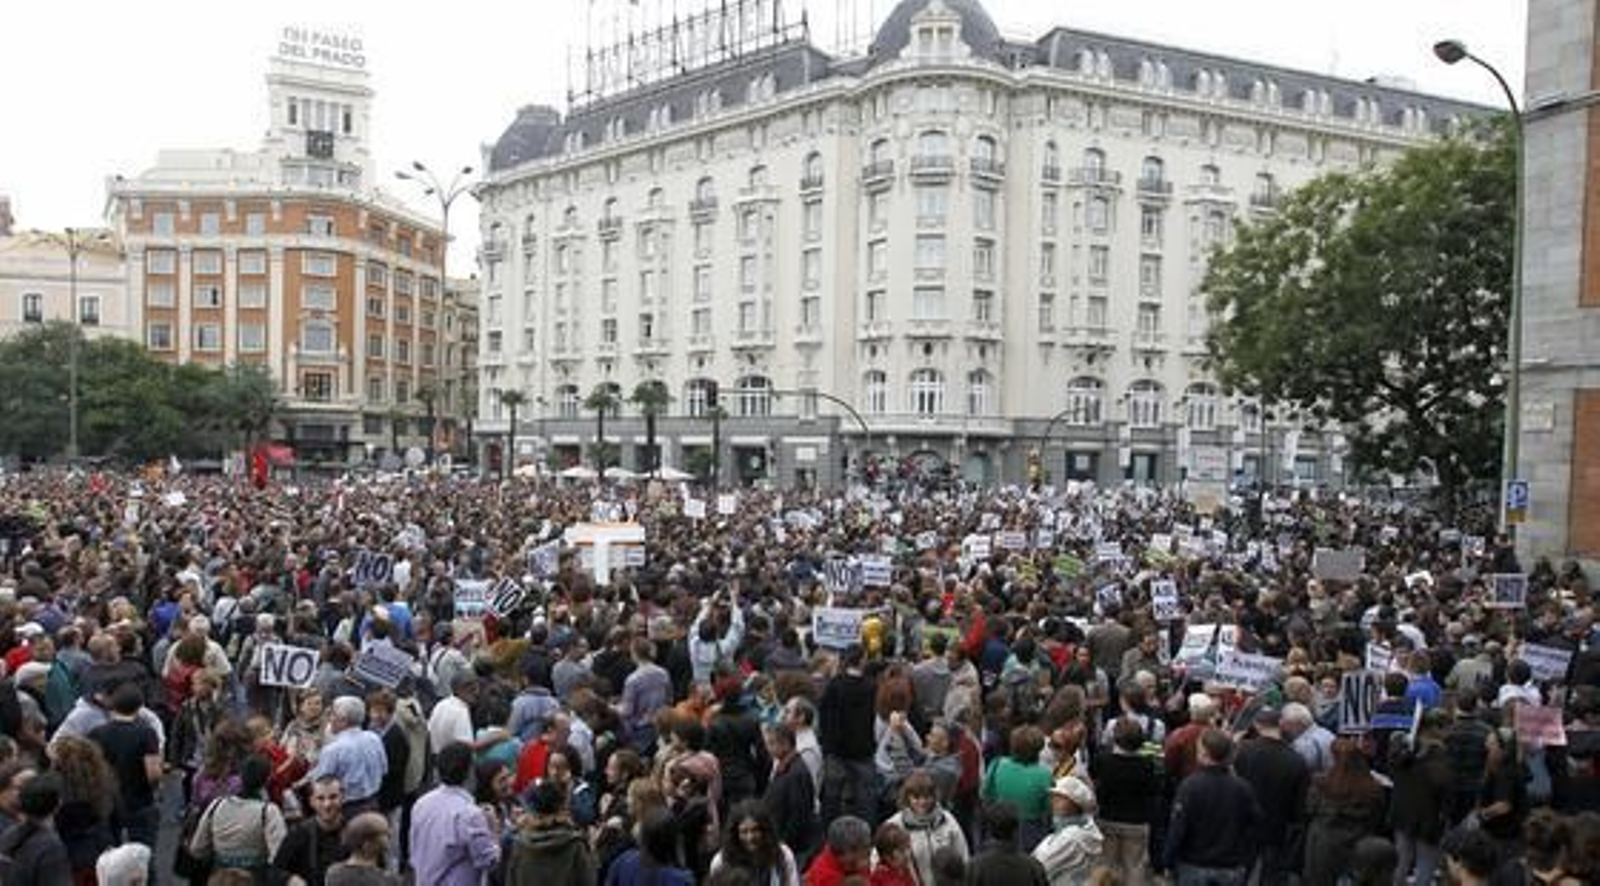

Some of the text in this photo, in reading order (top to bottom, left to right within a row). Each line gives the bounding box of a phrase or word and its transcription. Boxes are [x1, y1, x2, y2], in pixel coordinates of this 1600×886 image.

[279, 41, 366, 68] DEL PRADO
[312, 32, 363, 51] PASEO
[263, 647, 314, 685] NO
